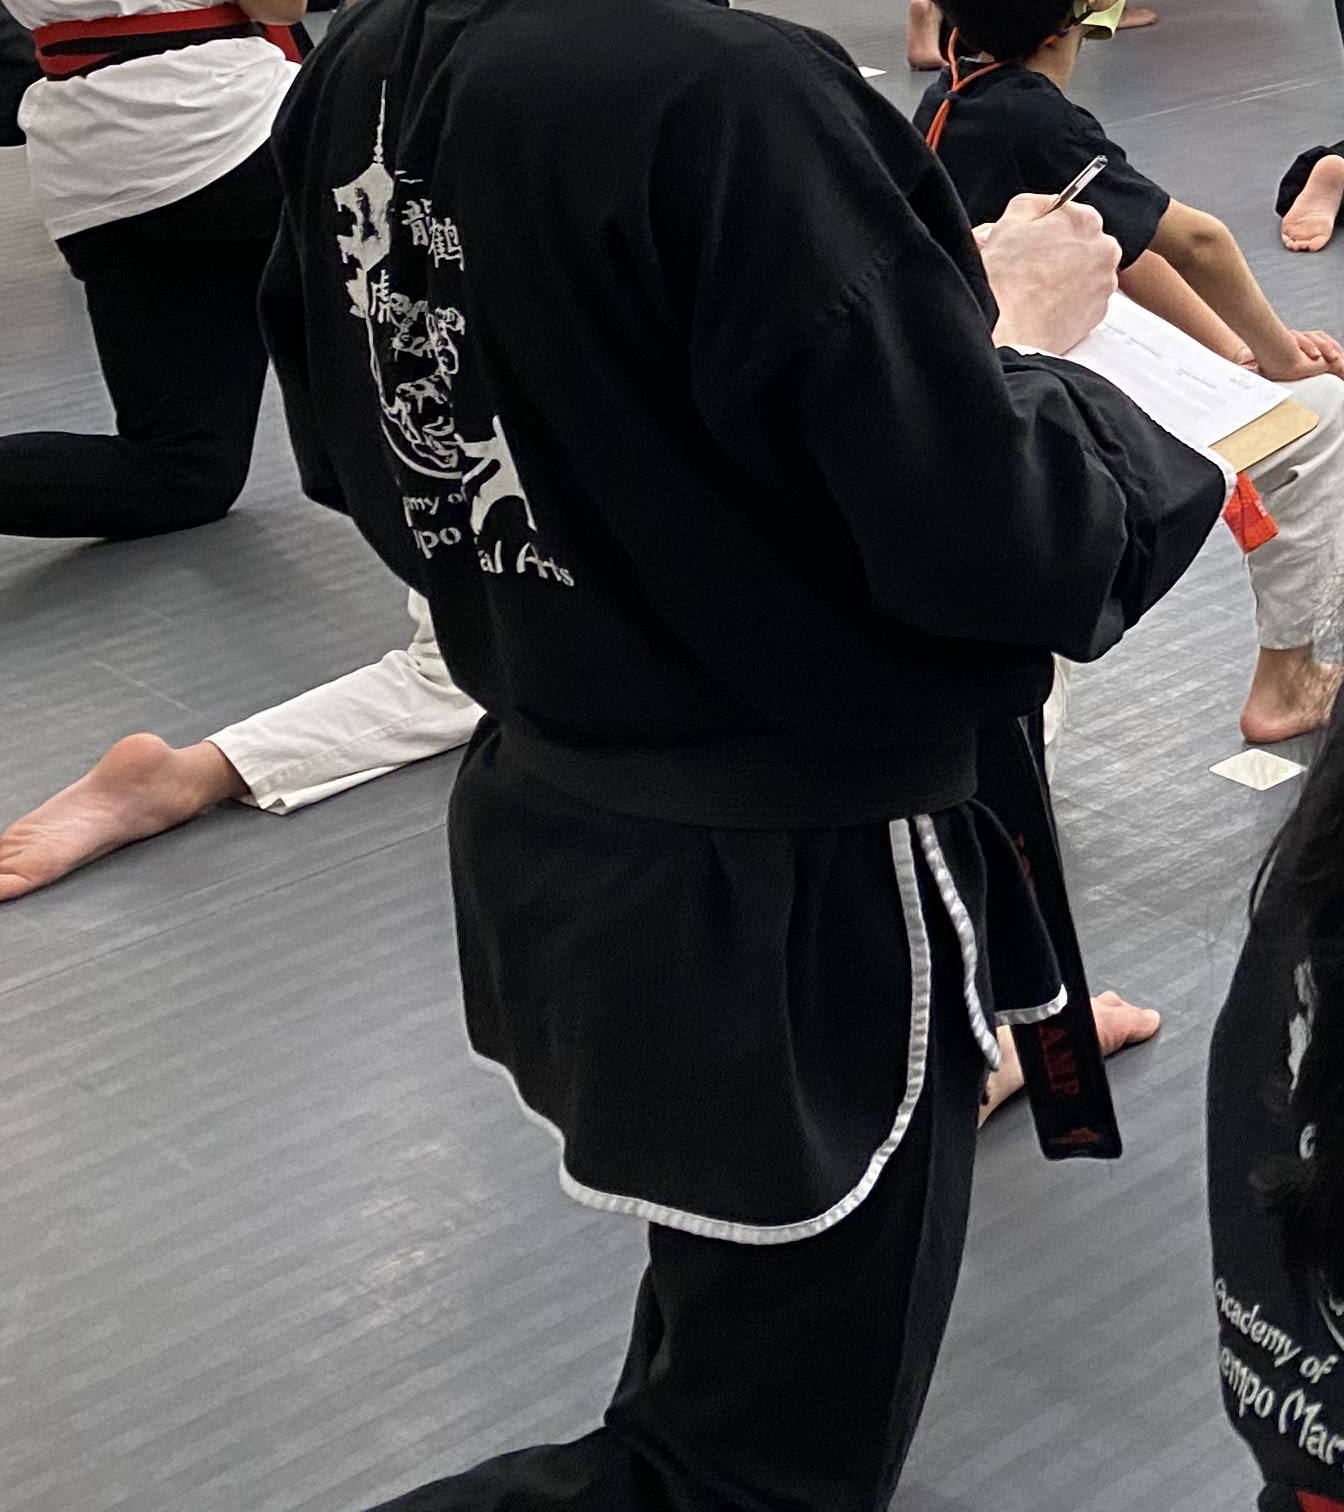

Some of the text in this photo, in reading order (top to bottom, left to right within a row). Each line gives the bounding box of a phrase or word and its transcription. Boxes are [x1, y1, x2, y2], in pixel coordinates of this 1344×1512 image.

[1214, 1277, 1339, 1384] Academy of
[1220, 1346, 1276, 1418] empo
